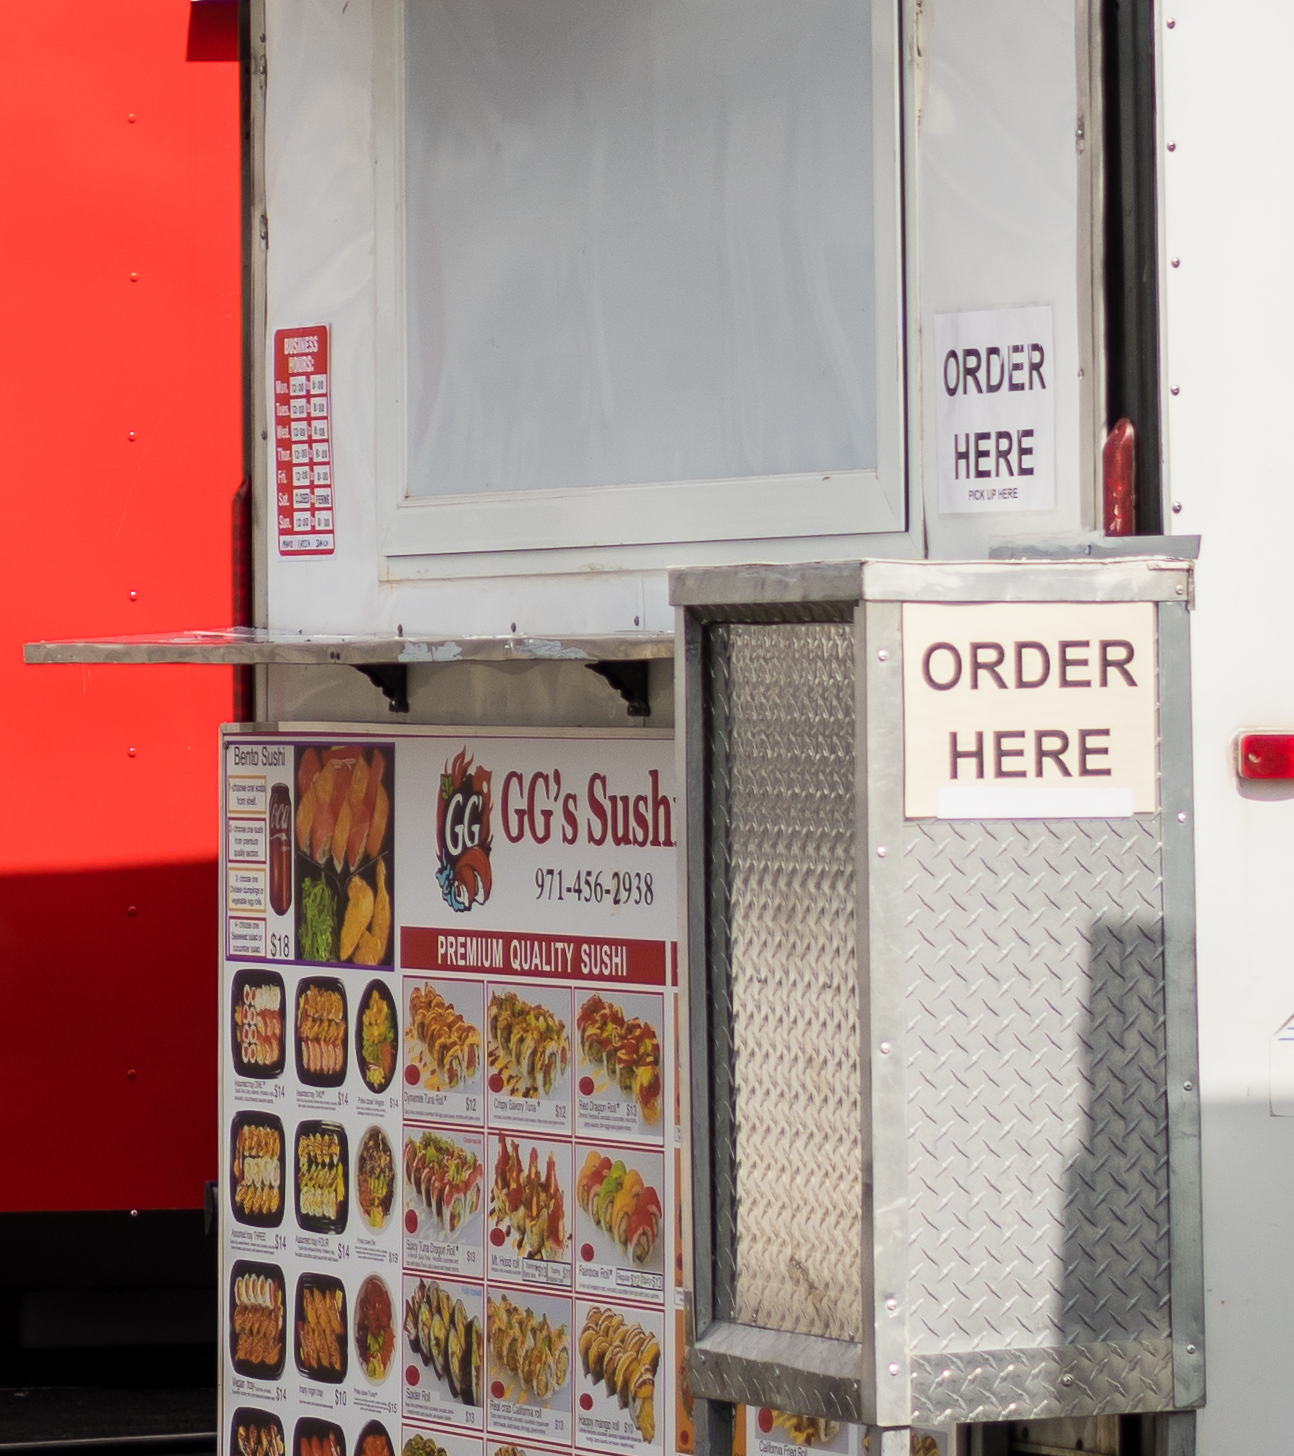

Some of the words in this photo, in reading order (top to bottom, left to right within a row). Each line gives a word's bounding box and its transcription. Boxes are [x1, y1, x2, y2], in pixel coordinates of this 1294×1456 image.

[284, 336, 318, 354] BUSINESS
[943, 342, 1046, 397] ORDER
[954, 429, 1035, 480] HERE
[968, 489, 985, 501] PICK
[987, 489, 997, 501] UP
[998, 487, 1018, 500] HERE
[921, 639, 1139, 692] ORDER
[234, 746, 259, 766] Bento
[261, 746, 286, 766] Sushi
[949, 728, 1112, 781] HERE
[501, 768, 579, 845] GG's
[587, 769, 677, 848] Sush
[535, 867, 654, 906] 971-456-2938
[270, 933, 289, 957] $18
[437, 935, 503, 968] PREMIUM
[510, 940, 574, 972] QUALITY
[580, 944, 627, 976] SUSHI
[274, 1084, 285, 1098] $14
[338, 1092, 349, 1106] $14
[465, 1096, 476, 1111] $12
[494, 1098, 508, 1112] Crispy
[579, 1099, 589, 1111] Red
[589, 1100, 607, 1114] Dragon
[555, 1104, 566, 1119] $12
[626, 1103, 637, 1117] $13
[275, 1234, 287, 1250] $14
[406, 1239, 417, 1253] Spicy
[418, 1241, 430, 1253] Tuna
[430, 1243, 446, 1256] Dragon
[338, 1243, 350, 1259] $14
[467, 1251, 475, 1263] $13
[276, 1387, 287, 1402] $14
[334, 1389, 347, 1406] $10
[406, 1388, 421, 1400] Spider
[422, 1390, 431, 1402] Roll
[388, 1401, 398, 1414] $15
[513, 1403, 534, 1418] California
[465, 1411, 475, 1424] $13
[555, 1419, 564, 1430] $13
[578, 1415, 594, 1430] Happy
[595, 1418, 610, 1432] mango
[624, 1420, 633, 1434] $10
[759, 1440, 783, 1456] California
[783, 1444, 796, 1456] Fried
